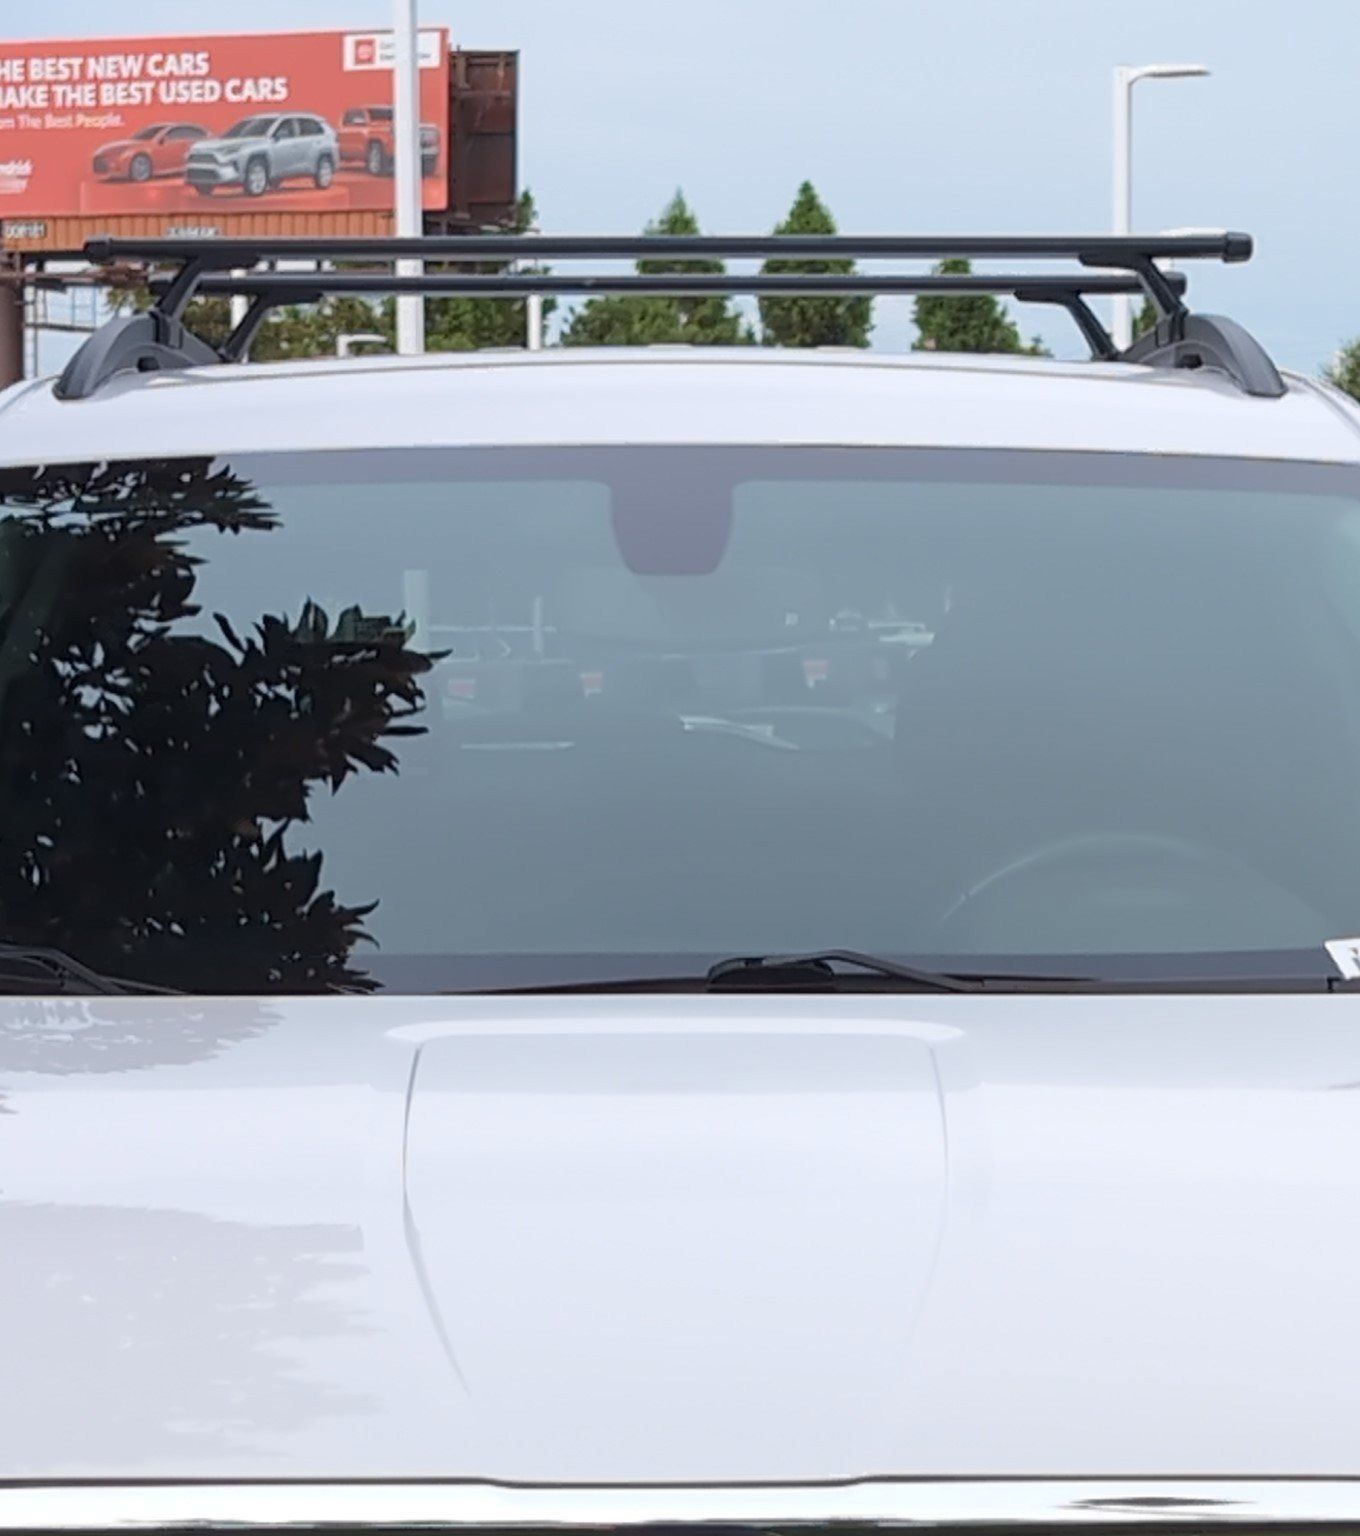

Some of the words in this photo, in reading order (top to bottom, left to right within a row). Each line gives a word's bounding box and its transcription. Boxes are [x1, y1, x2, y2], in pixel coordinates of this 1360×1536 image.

[29, 56, 83, 81] BEST
[86, 54, 144, 79] NEW
[147, 51, 209, 77] CARS
[51, 82, 97, 107] THE
[99, 80, 155, 106] BEST
[158, 78, 221, 104] USED
[224, 76, 288, 102] CARS
[17, 113, 42, 129] The
[44, 112, 74, 129] Best
